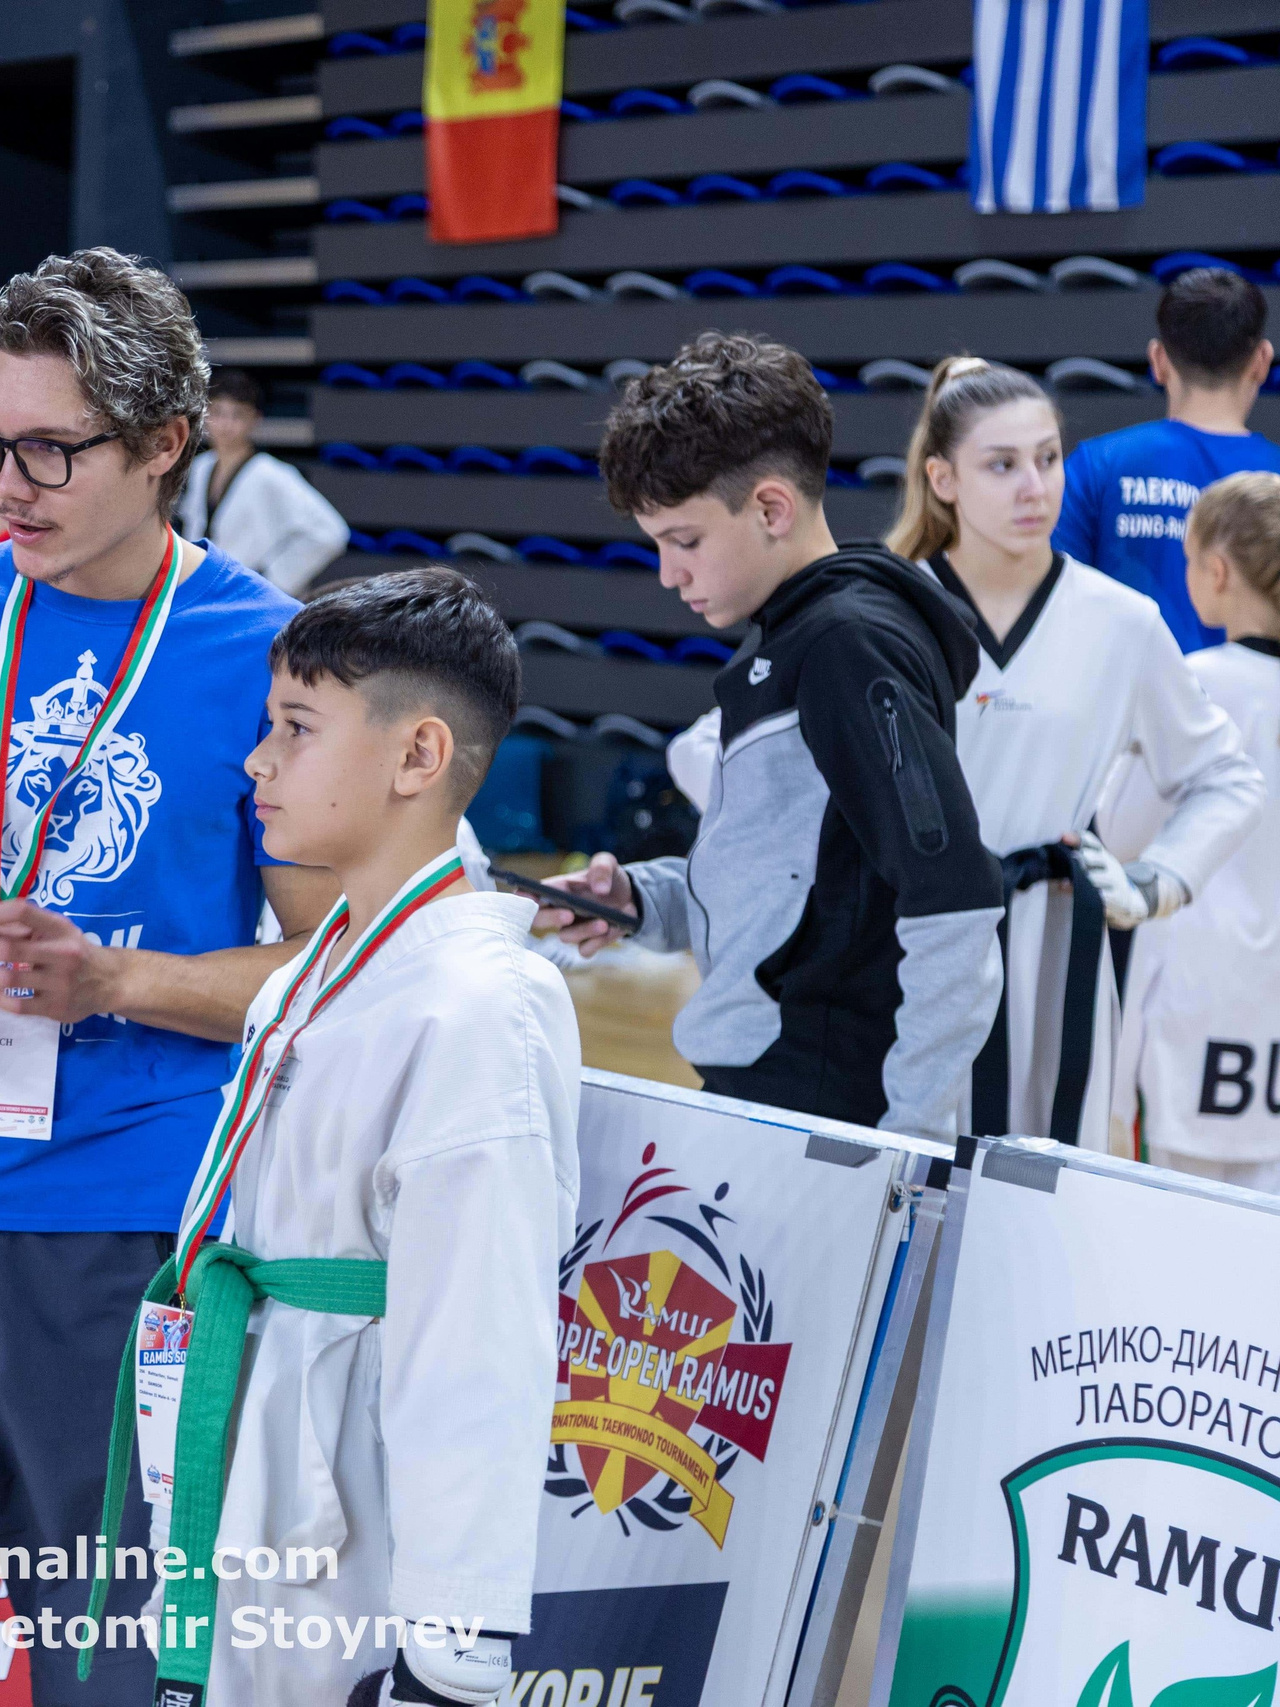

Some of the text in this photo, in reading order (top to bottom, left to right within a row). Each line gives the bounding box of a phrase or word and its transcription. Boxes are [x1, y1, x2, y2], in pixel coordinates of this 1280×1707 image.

[143, 1351, 174, 1364] RAMUS
[606, 1336, 676, 1392] OPEN
[675, 1354, 776, 1422] RAMUS
[601, 1417, 655, 1446] TAEKWONDO
[656, 1436, 710, 1489] TOURNAMENT
[1057, 1492, 1280, 1632] RAMU
